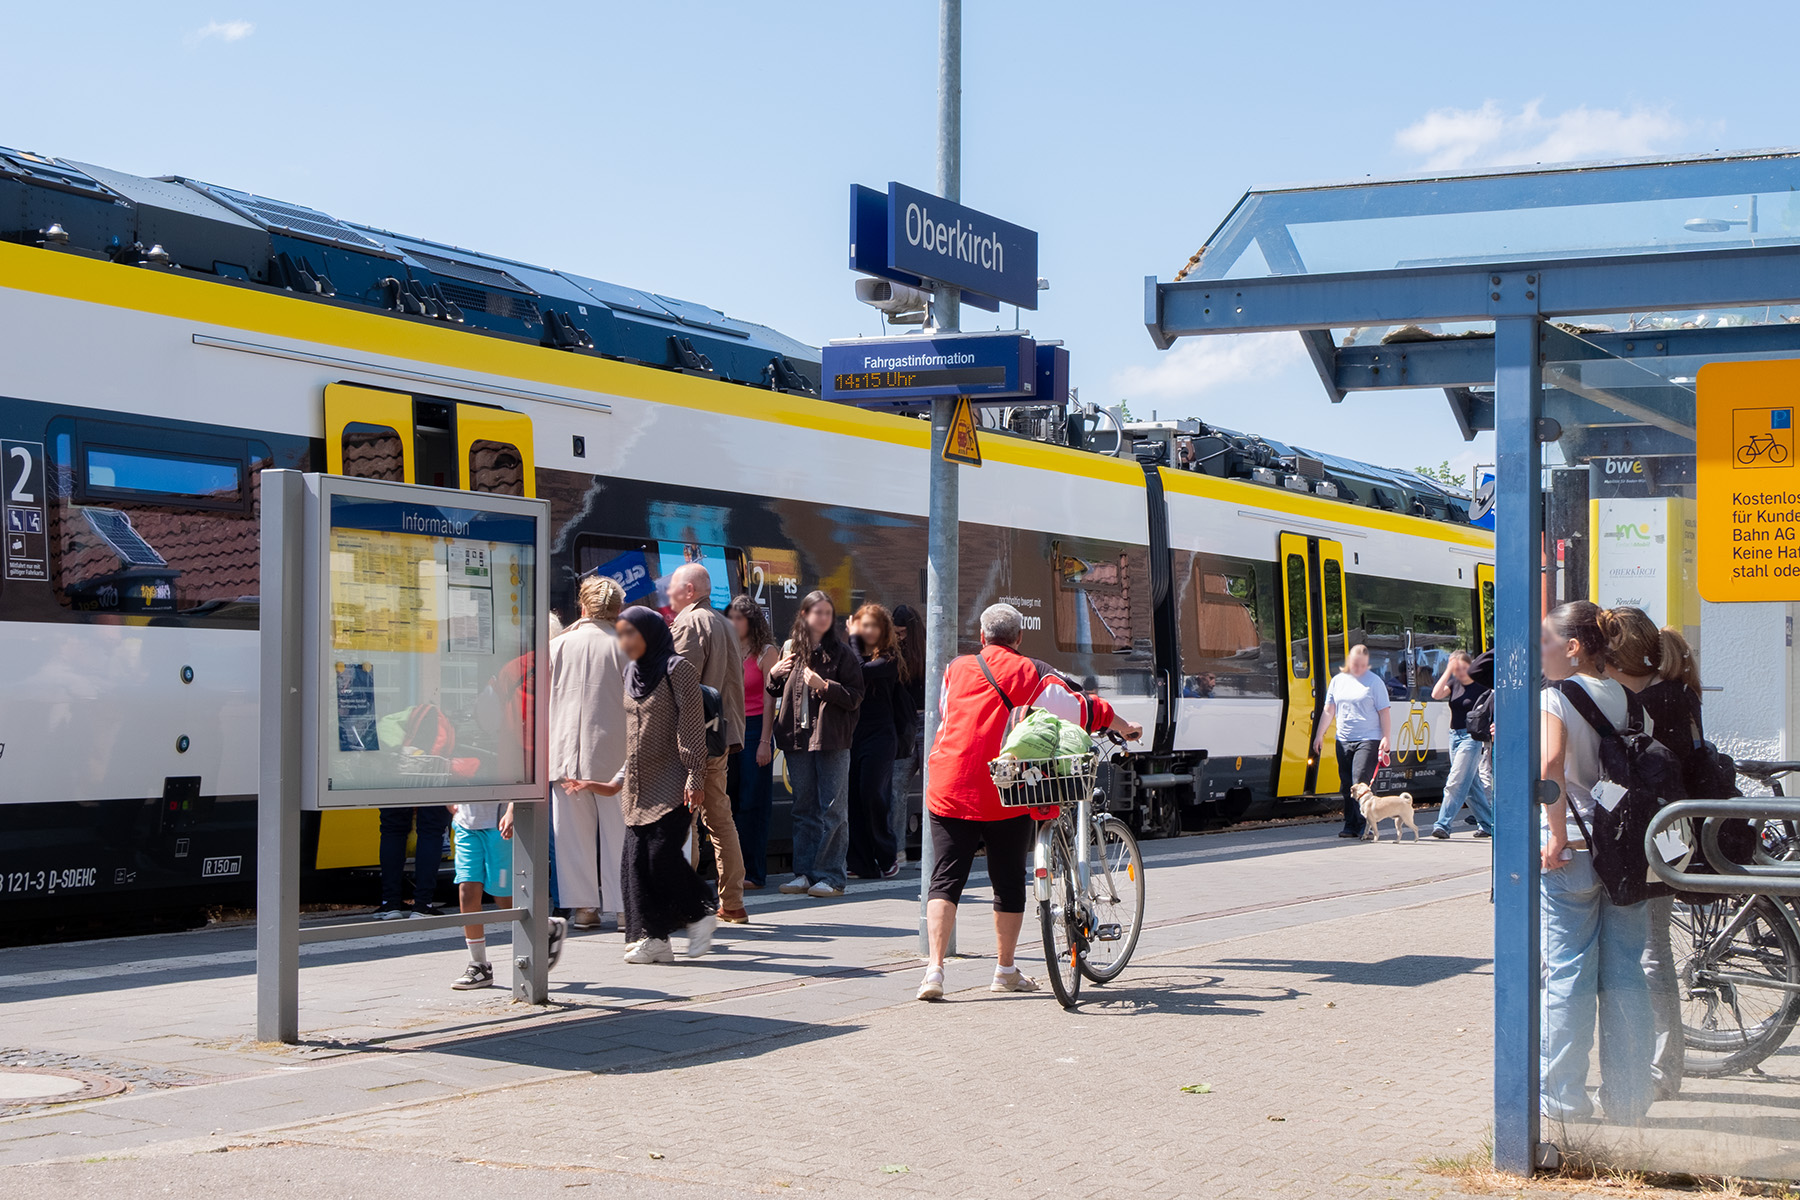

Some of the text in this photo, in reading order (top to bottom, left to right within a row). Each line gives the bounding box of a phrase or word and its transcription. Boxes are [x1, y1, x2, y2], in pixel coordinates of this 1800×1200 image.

[906, 203, 1003, 273] Oberkirch
[864, 353, 975, 370] Fahrgastinformation
[836, 371, 917, 389] 14:15 Uhr
[10, 446, 34, 503] 2
[402, 511, 470, 536] Information
[1732, 510, 1752, 523] für
[1733, 527, 1796, 541] Bahn AG
[1733, 546, 1773, 560] Keine
[1609, 567, 1656, 576] OBERKIRCH
[1733, 564, 1769, 578] stahl
[753, 566, 766, 605] 2
[784, 577, 798, 594] RS
[1020, 616, 1041, 630] trom
[206, 859, 238, 874] R 150 m
[8, 871, 46, 892] 121-3
[48, 867, 97, 894] D-SDEHC
